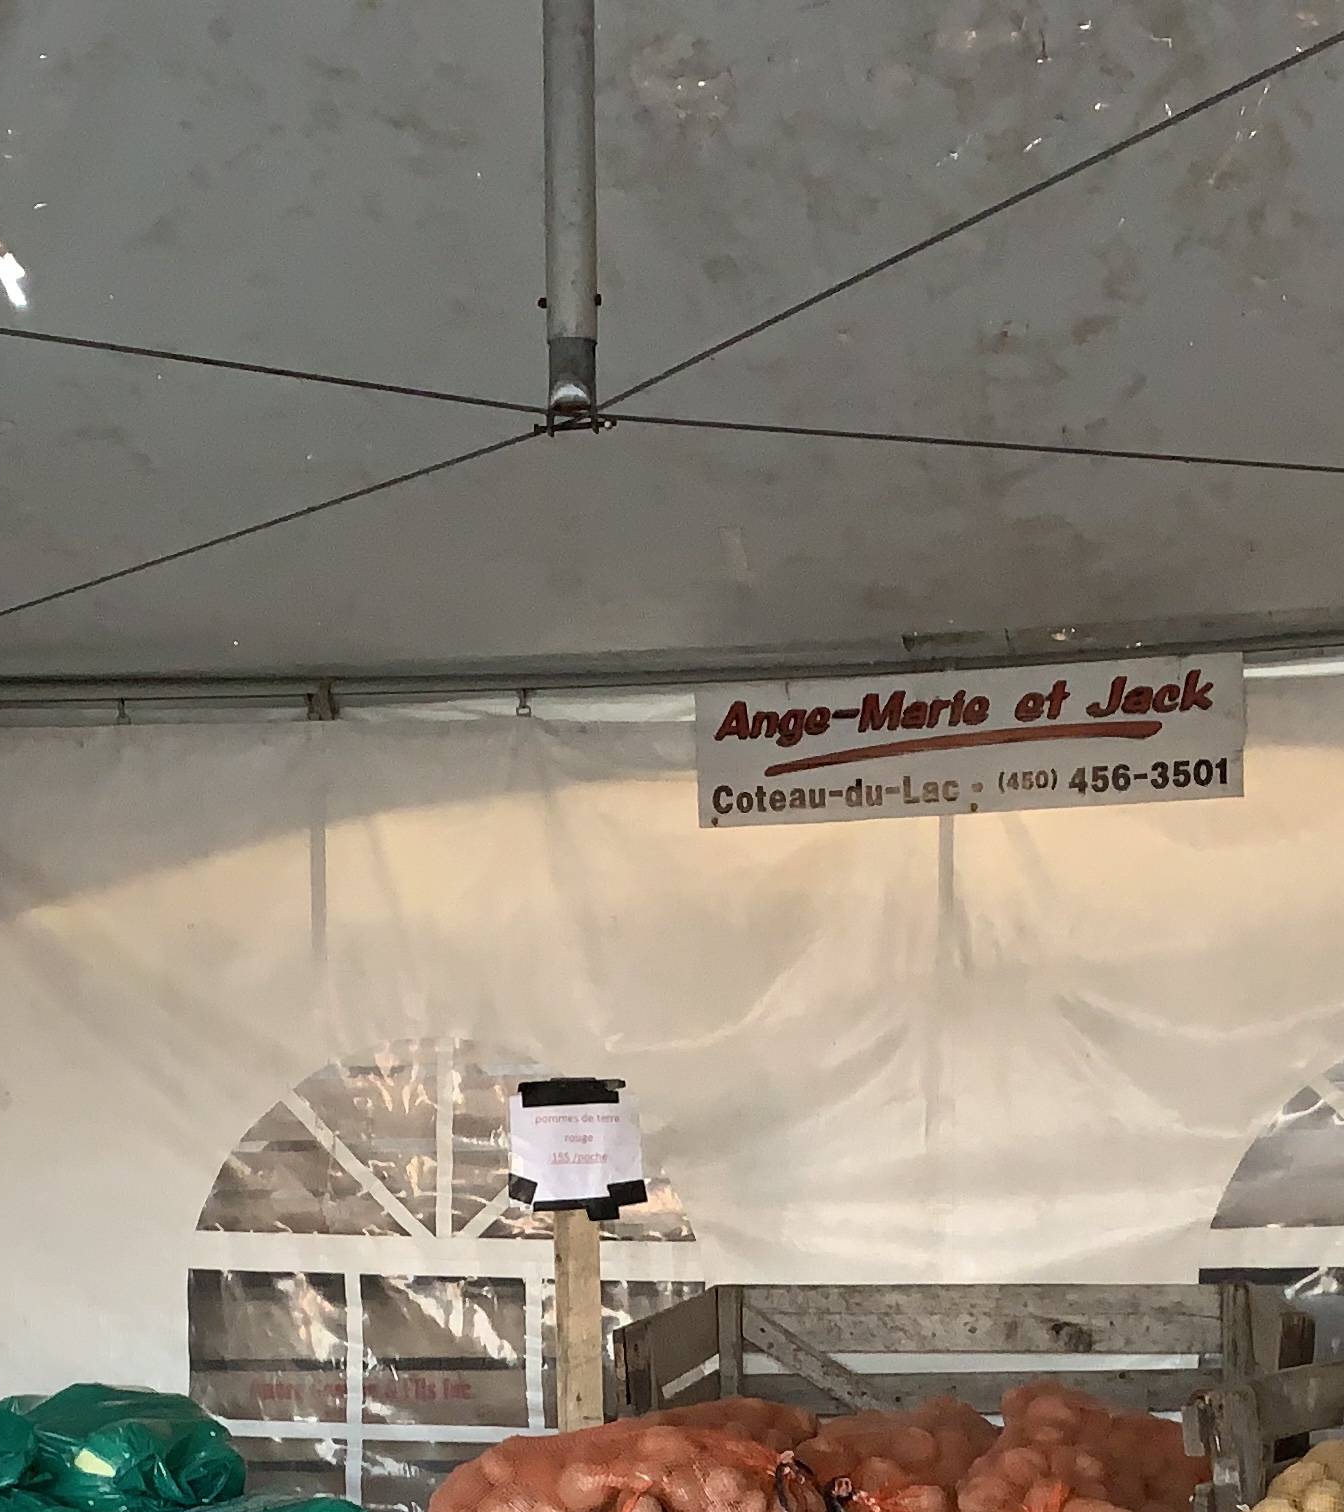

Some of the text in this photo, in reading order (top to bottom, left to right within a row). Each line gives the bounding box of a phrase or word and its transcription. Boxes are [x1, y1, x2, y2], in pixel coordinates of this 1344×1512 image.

[715, 668, 1214, 746] Ange-Marie et Jack
[712, 757, 1228, 815] Coteau-du-Lac (450) 456-3501
[534, 1113, 620, 1125] pommes de terre
[564, 1132, 594, 1144] rouge
